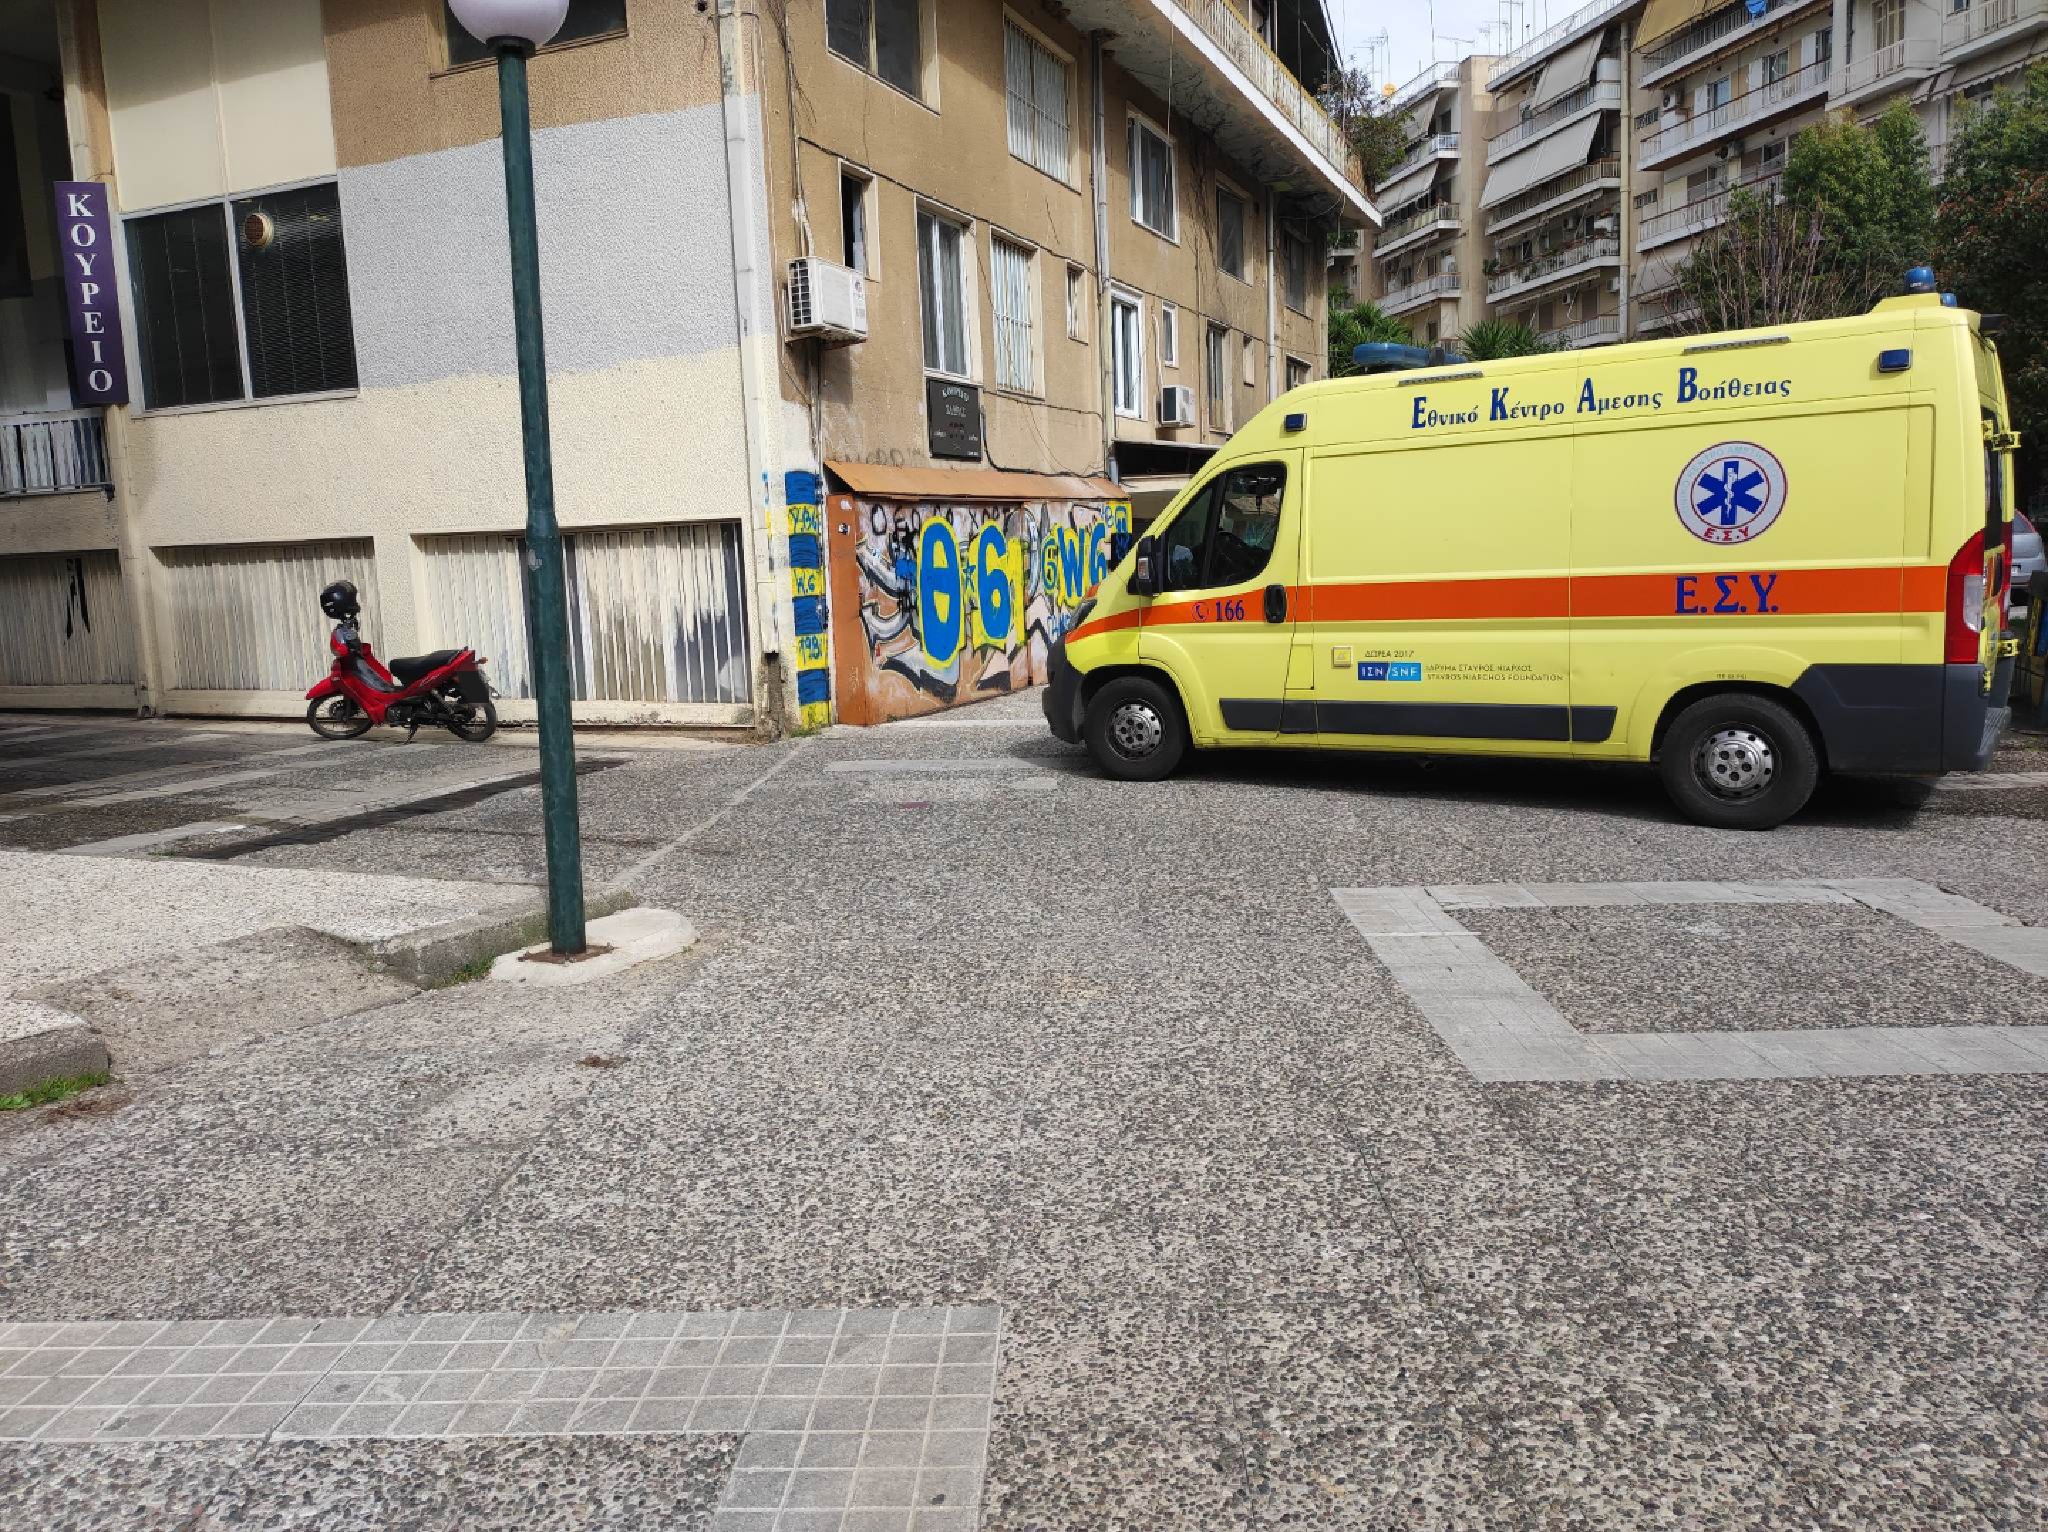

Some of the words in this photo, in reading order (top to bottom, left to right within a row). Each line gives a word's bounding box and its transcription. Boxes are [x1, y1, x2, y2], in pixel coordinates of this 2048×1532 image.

[67, 194, 113, 392] ΚΟΥΡΕΙΟ
[1412, 396, 1479, 429] Εθνικό
[1490, 387, 1565, 421] Κέντρο
[1577, 377, 1664, 415] Αμεσης
[1677, 367, 1792, 403] Βοήθειας
[1215, 599, 1245, 622] 166
[1675, 574, 1779, 613] Ε.Σ.Υ.
[1394, 650, 1415, 658] 2017
